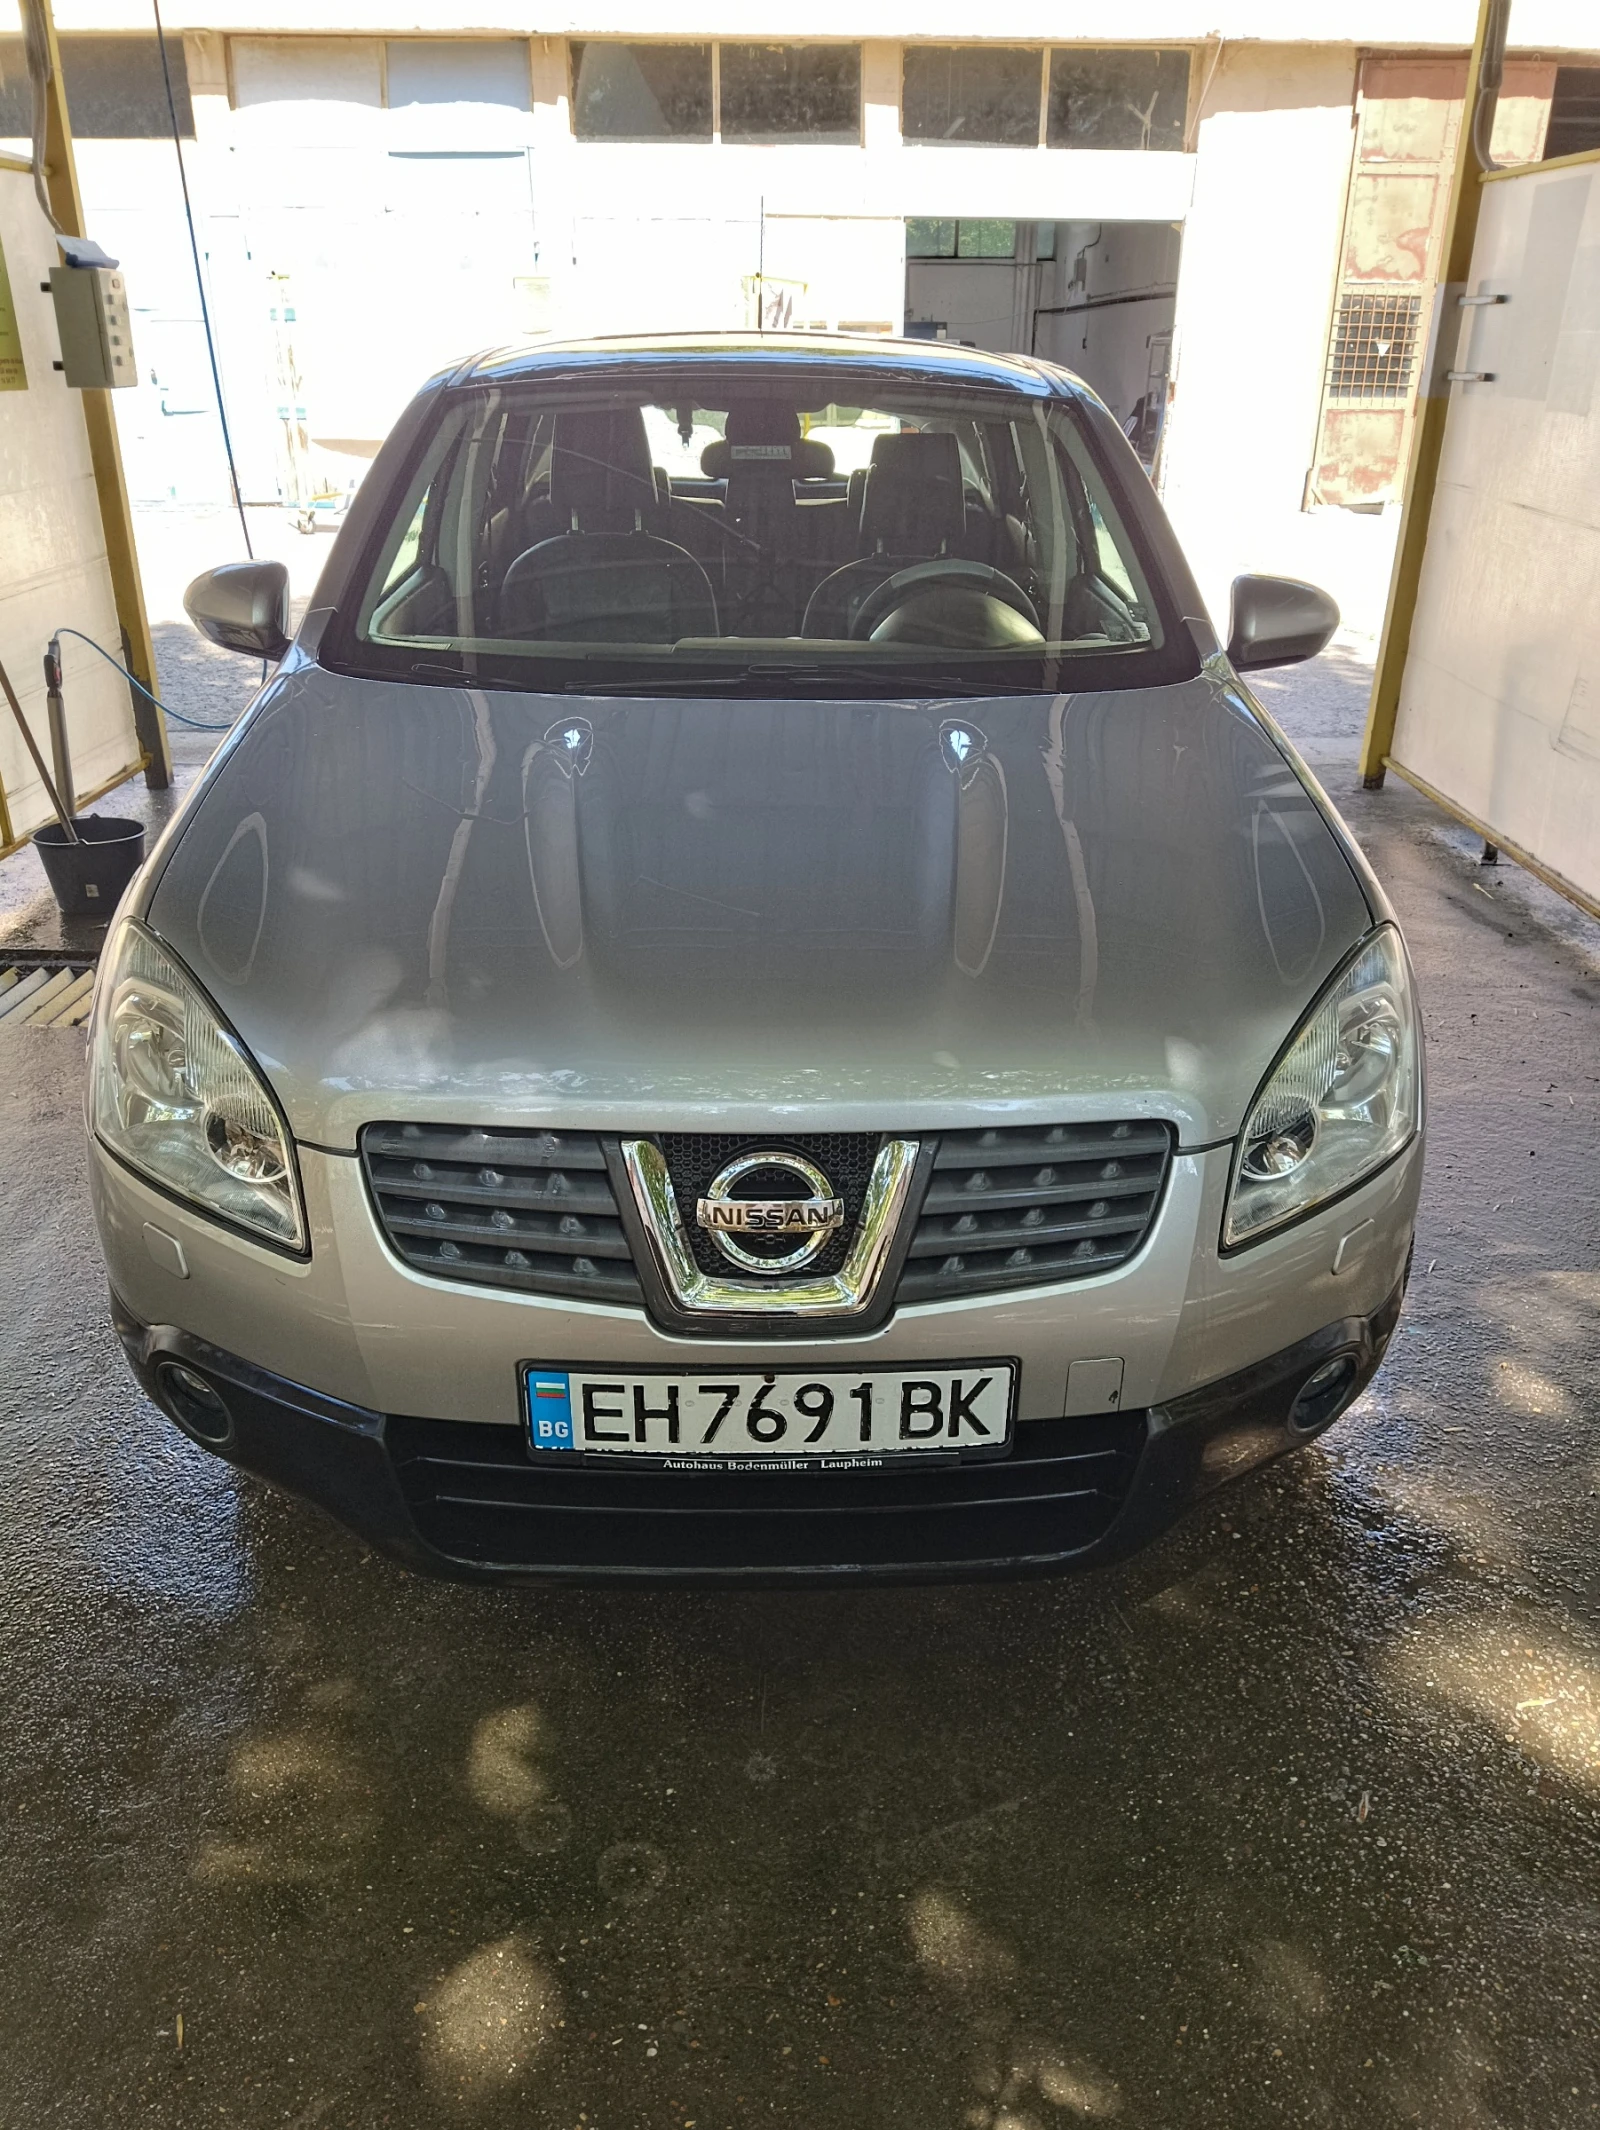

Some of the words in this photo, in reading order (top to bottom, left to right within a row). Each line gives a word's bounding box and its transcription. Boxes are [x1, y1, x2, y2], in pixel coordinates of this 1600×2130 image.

[712, 1206, 829, 1228] NISSAN
[582, 1383, 681, 1443] EH
[698, 1382, 872, 1444] 7691
[898, 1377, 994, 1440] BK
[538, 1420, 569, 1438] BG
[662, 1459, 724, 1471] Autohaus
[727, 1460, 809, 1471] Bodenmüller
[820, 1458, 883, 1470] Laupheim
